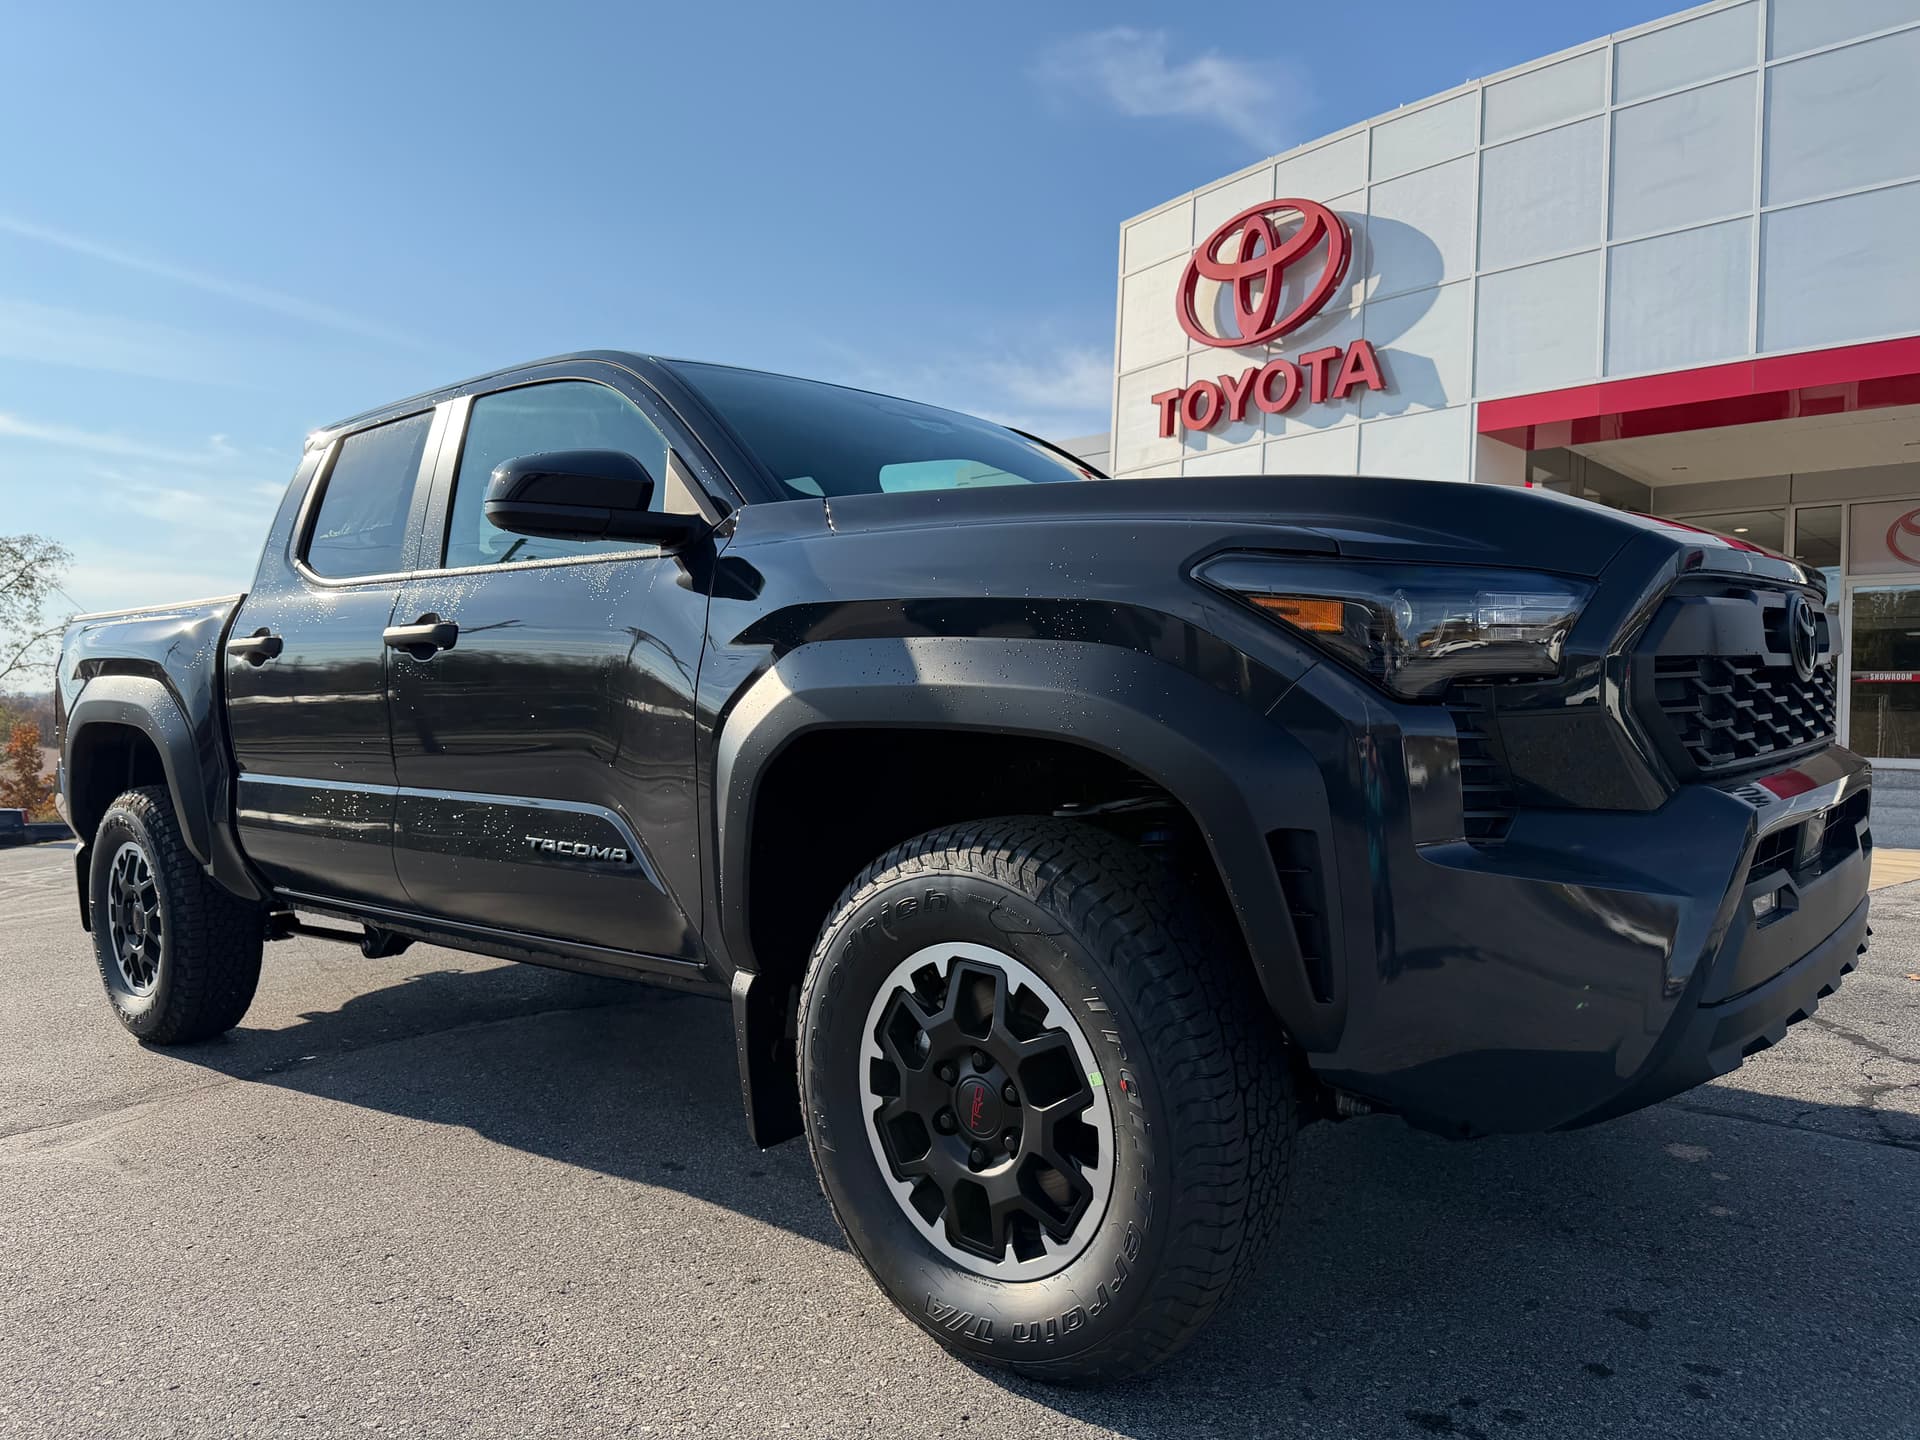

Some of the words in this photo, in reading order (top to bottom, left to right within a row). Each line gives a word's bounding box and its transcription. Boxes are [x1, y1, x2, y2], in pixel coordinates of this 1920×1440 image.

[1152, 338, 1386, 438] TOYOTA
[1870, 672, 1912, 681] SHOWROOM
[525, 836, 628, 861] TACOMA
[970, 1086, 985, 1129] TRD
